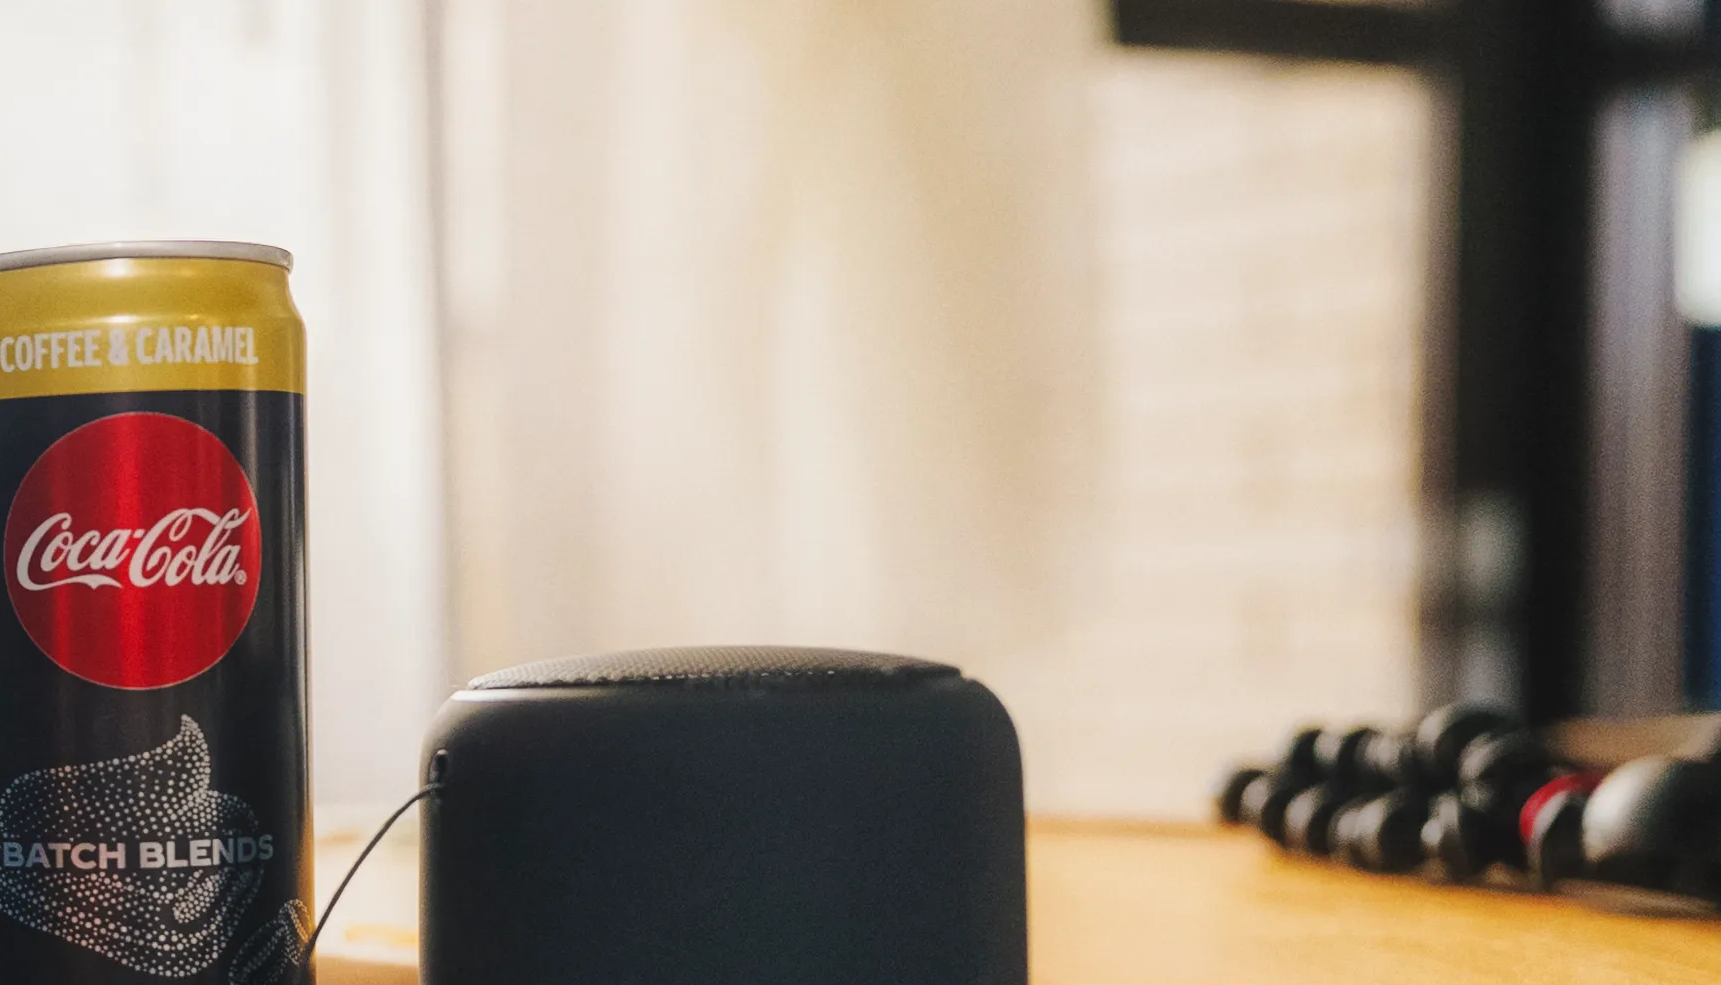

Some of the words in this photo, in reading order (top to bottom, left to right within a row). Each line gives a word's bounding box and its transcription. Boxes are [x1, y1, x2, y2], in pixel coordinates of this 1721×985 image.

[0, 328, 102, 373] COFFEE
[107, 327, 129, 366] &
[136, 326, 259, 365] CARAMEL
[17, 507, 251, 591] Coca-Cola
[3, 841, 126, 870] BATCH
[139, 834, 274, 870] BLENDS
